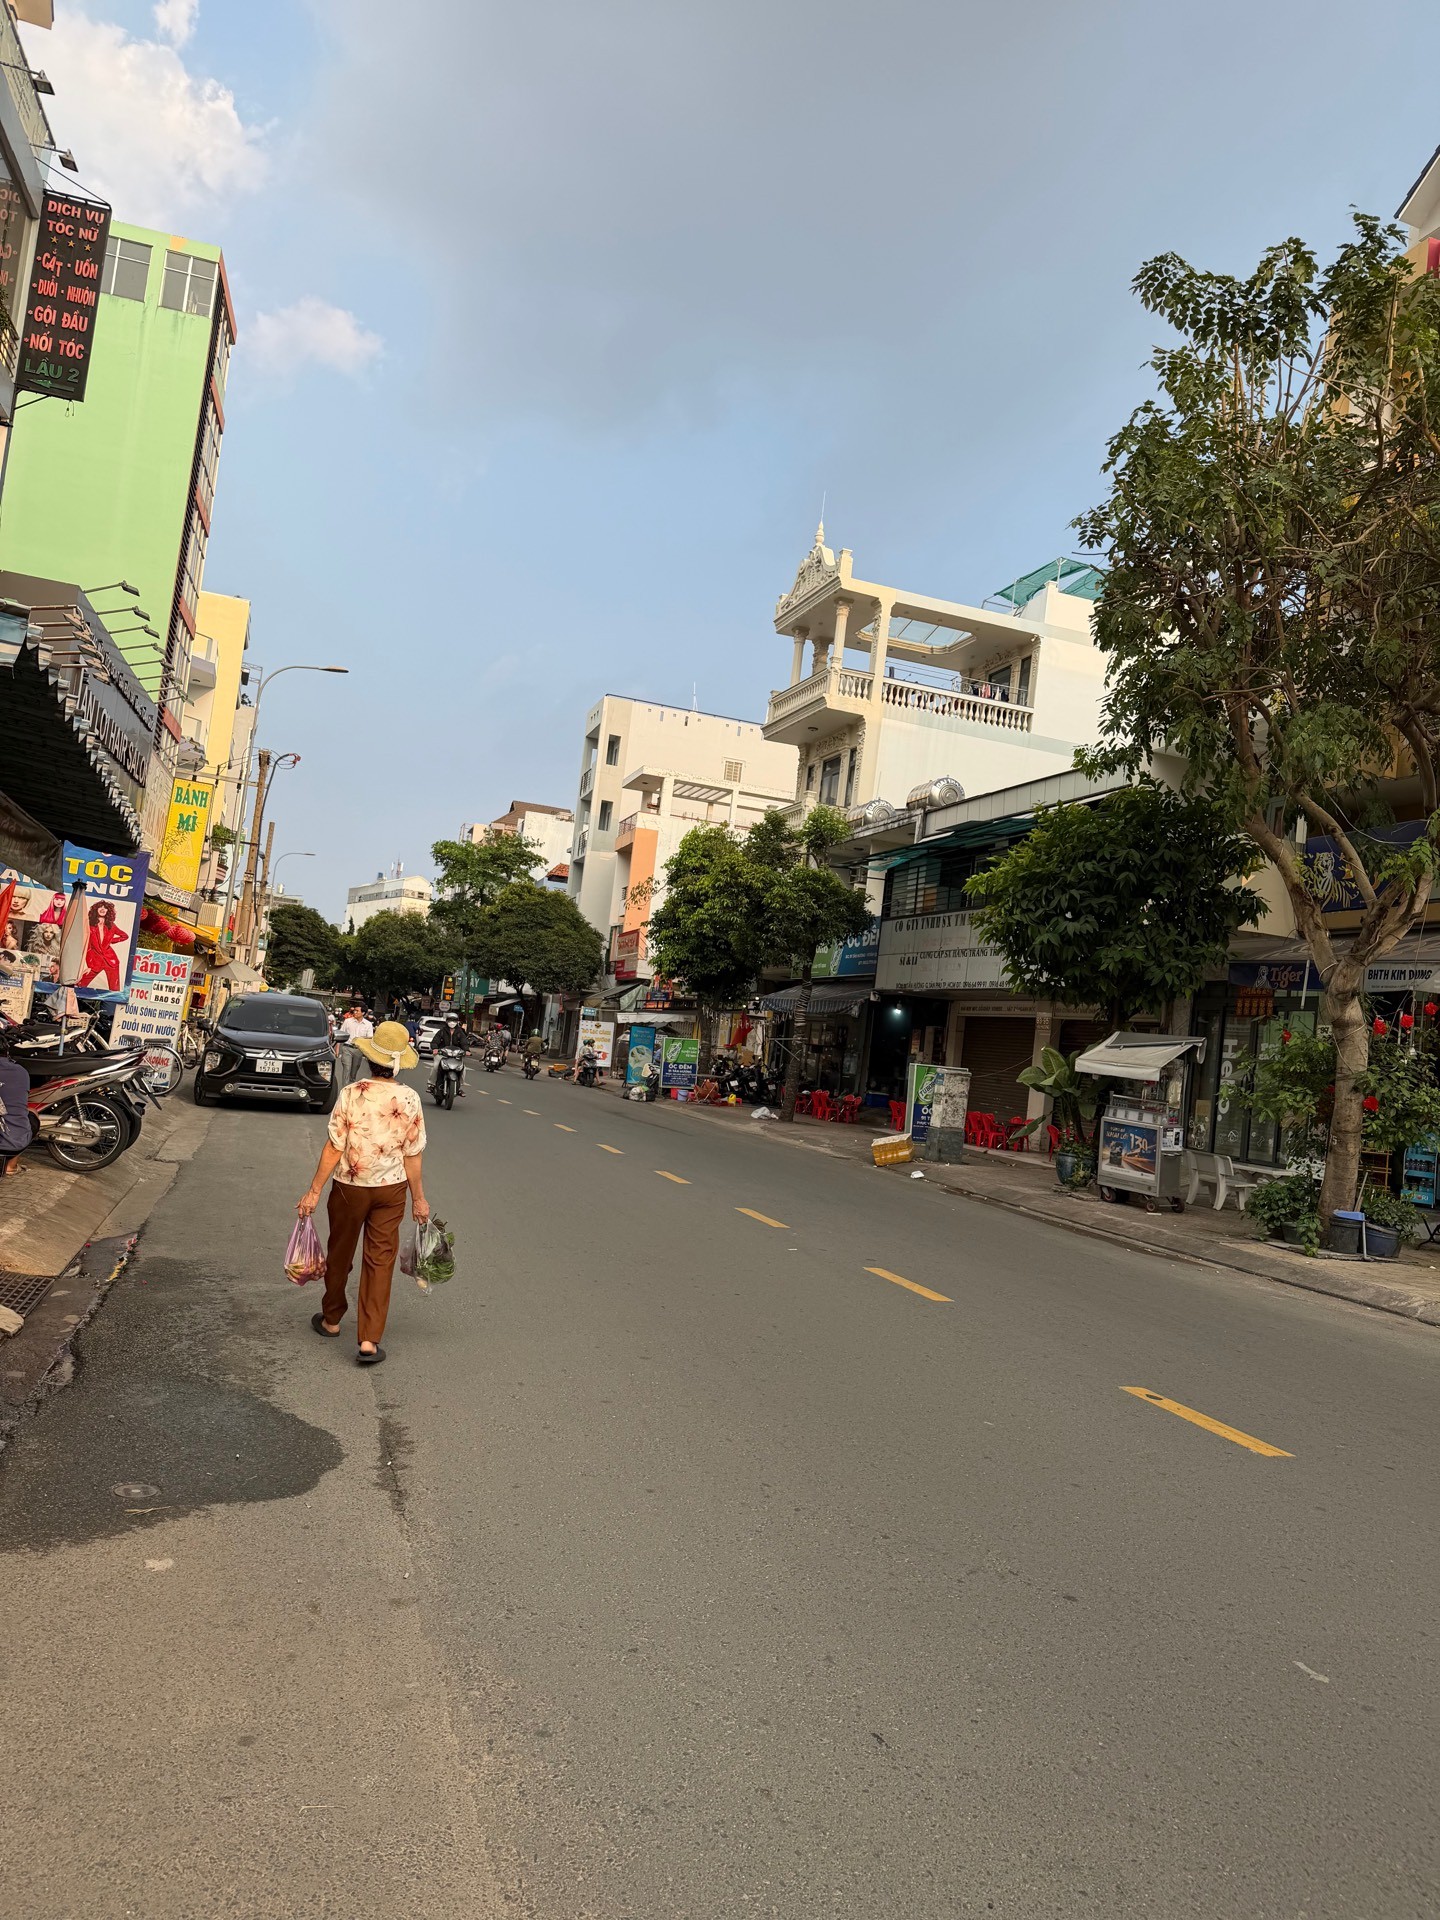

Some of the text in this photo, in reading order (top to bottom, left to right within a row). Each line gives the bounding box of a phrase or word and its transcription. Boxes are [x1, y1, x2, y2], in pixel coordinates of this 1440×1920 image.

[47, 200, 105, 227] DỊCH VỤ
[47, 218, 100, 242] TÓC NỮ
[42, 248, 63, 277] CẮT
[74, 258, 99, 280] UỐN
[66, 286, 96, 309] NHUỘM
[33, 305, 89, 333] GỘI ĐẦU
[29, 331, 85, 360] NỐI TÓC
[24, 357, 80, 383] LẦU 2
[108, 719, 128, 766] HAIR
[174, 783, 209, 808] BÁNH
[176, 810, 199, 832] MÌ
[65, 856, 134, 883] TÓC
[86, 880, 134, 898] NỮ
[164, 960, 188, 981] lợi
[1367, 969, 1433, 981] BHTH KIM DUNG
[154, 994, 169, 1003] BAO
[139, 1005, 157, 1018] SÓNG
[157, 1009, 179, 1021] HIPPIE
